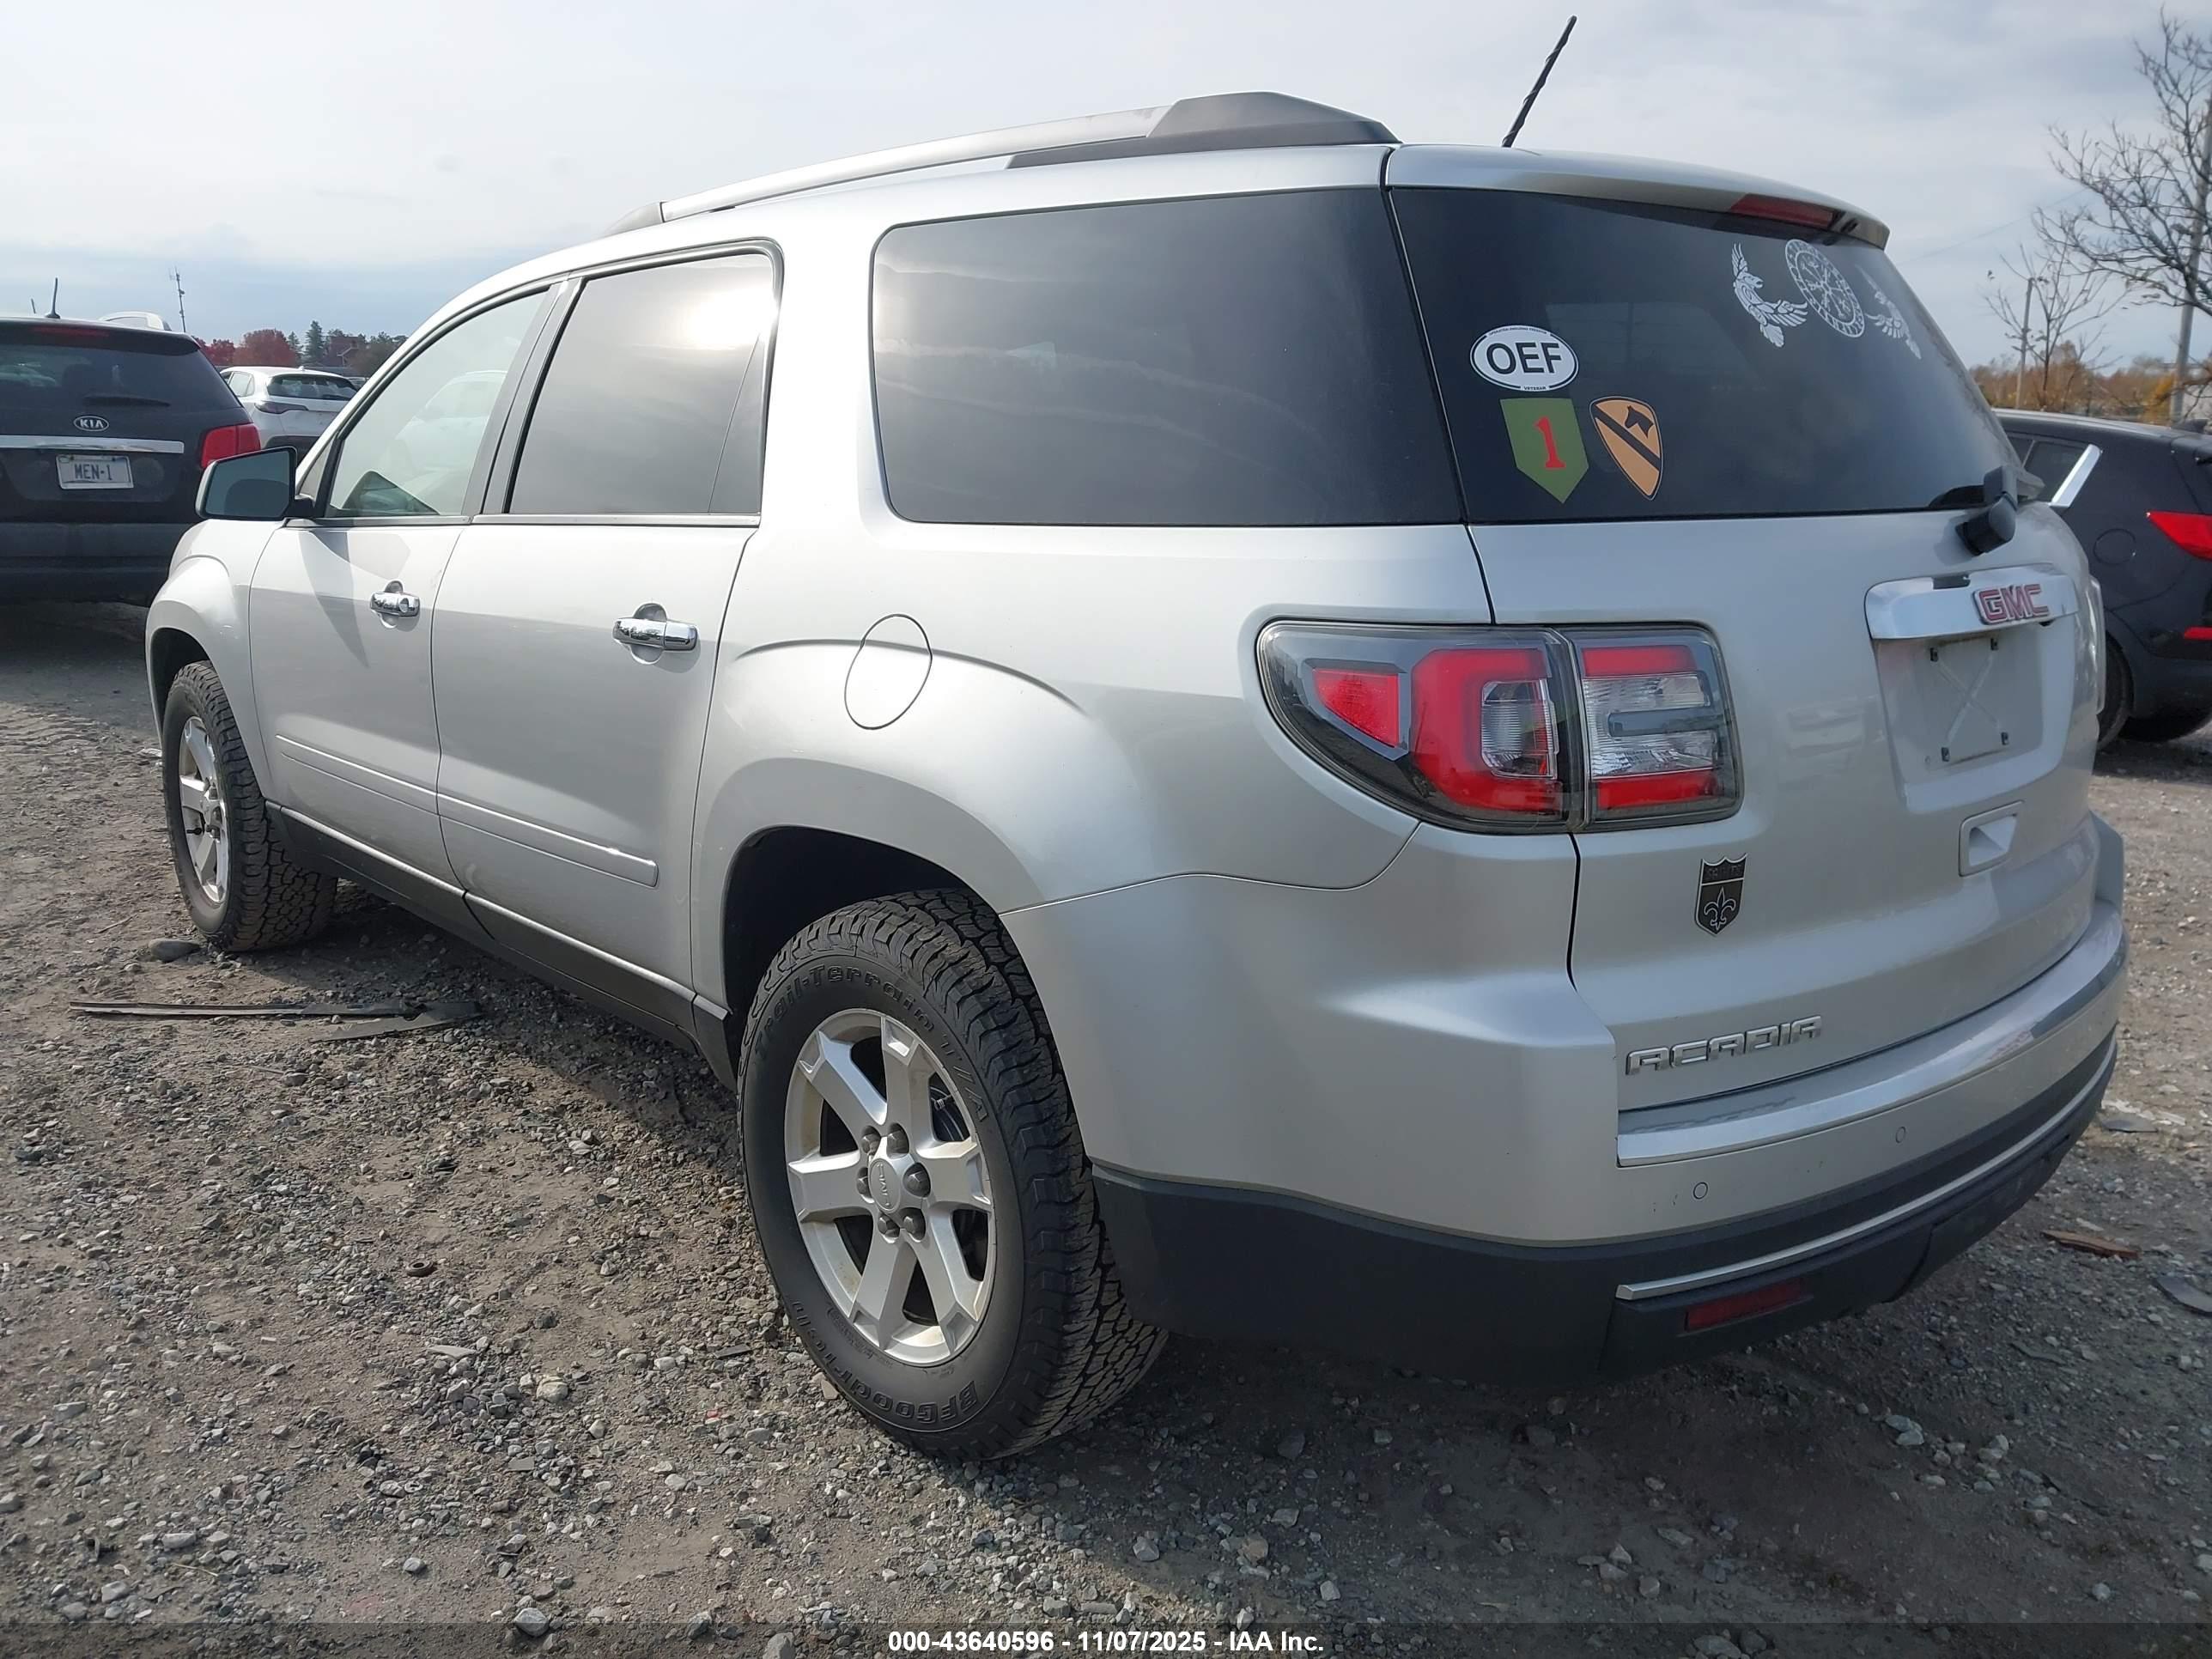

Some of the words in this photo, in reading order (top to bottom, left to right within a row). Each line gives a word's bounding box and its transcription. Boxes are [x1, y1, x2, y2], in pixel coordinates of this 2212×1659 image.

[1486, 342, 1562, 374] OEF
[80, 418, 104, 428] KIA
[1532, 416, 1566, 469] 1
[74, 464, 112, 481] MEN-1
[1978, 583, 2051, 623] GMC
[1625, 1015, 1821, 1075] ACADIA
